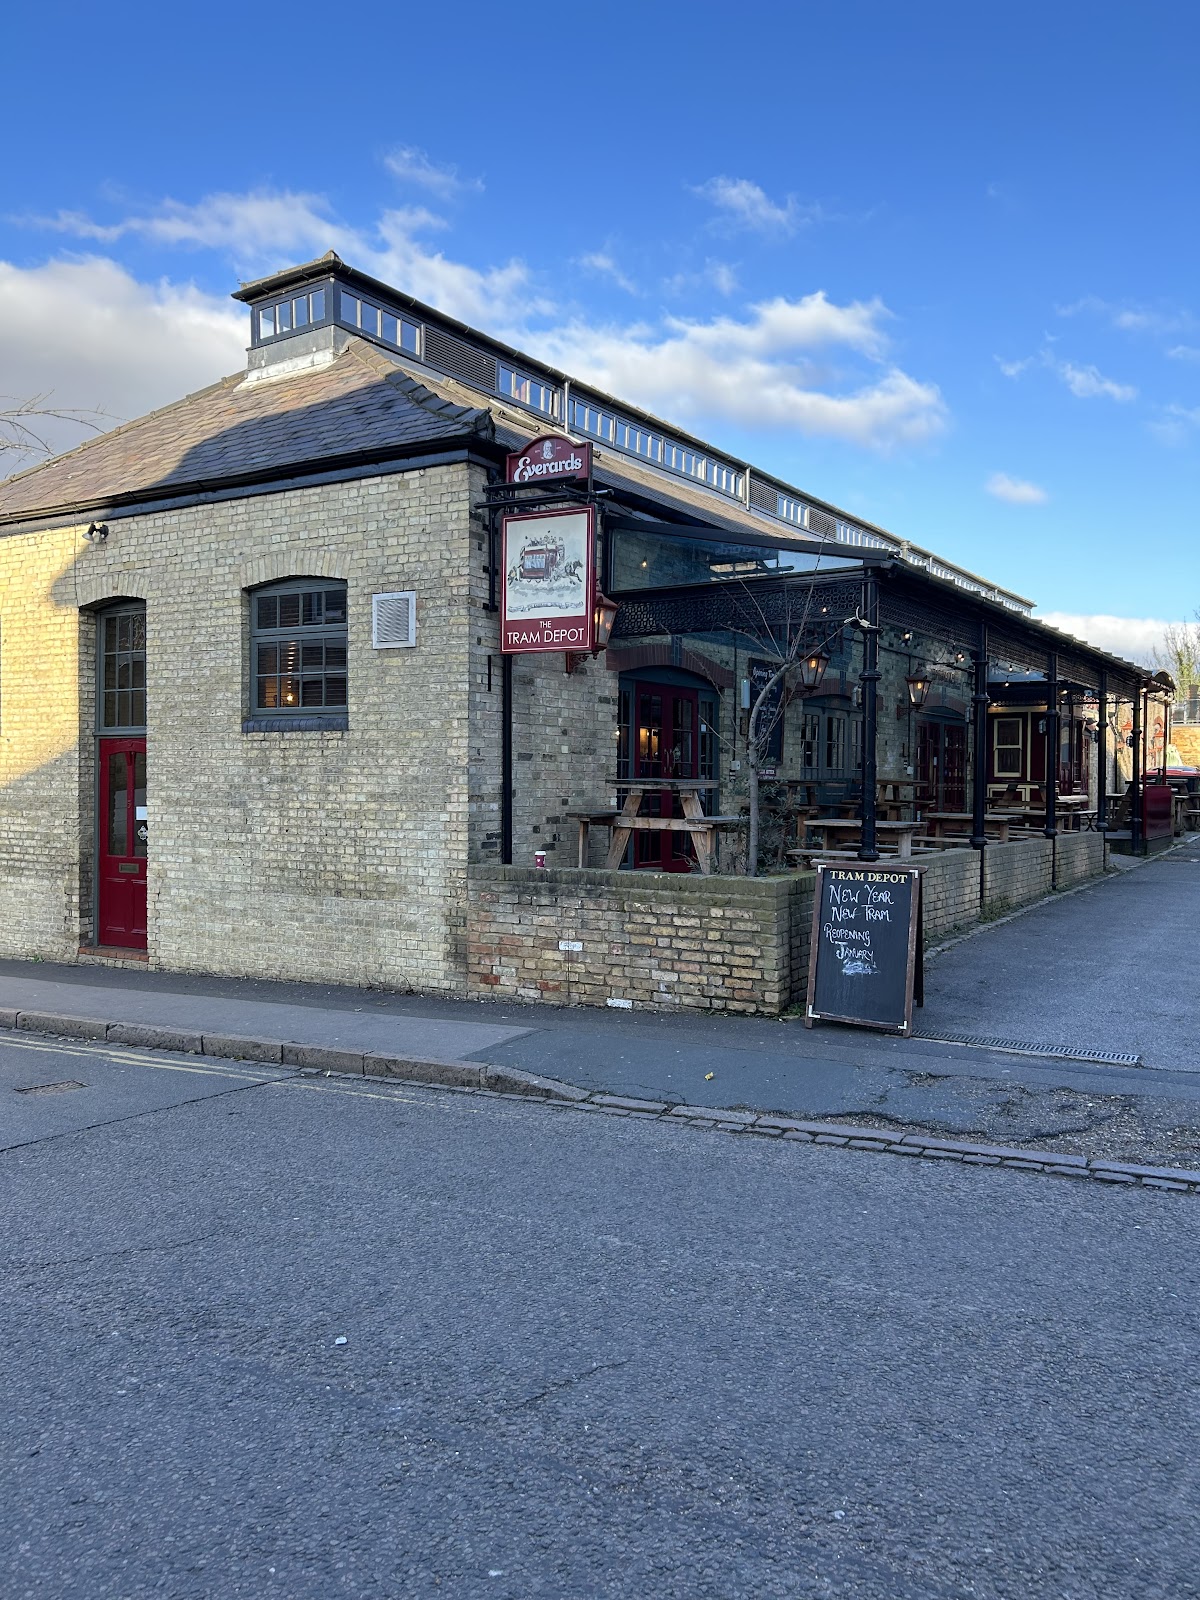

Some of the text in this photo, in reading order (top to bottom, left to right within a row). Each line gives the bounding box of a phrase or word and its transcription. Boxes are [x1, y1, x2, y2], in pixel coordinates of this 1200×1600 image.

[514, 453, 582, 482] Everards
[540, 620, 552, 629] THE
[507, 628, 584, 644] TRAM DEPOT
[830, 871, 907, 884] TRAM DEPOT
